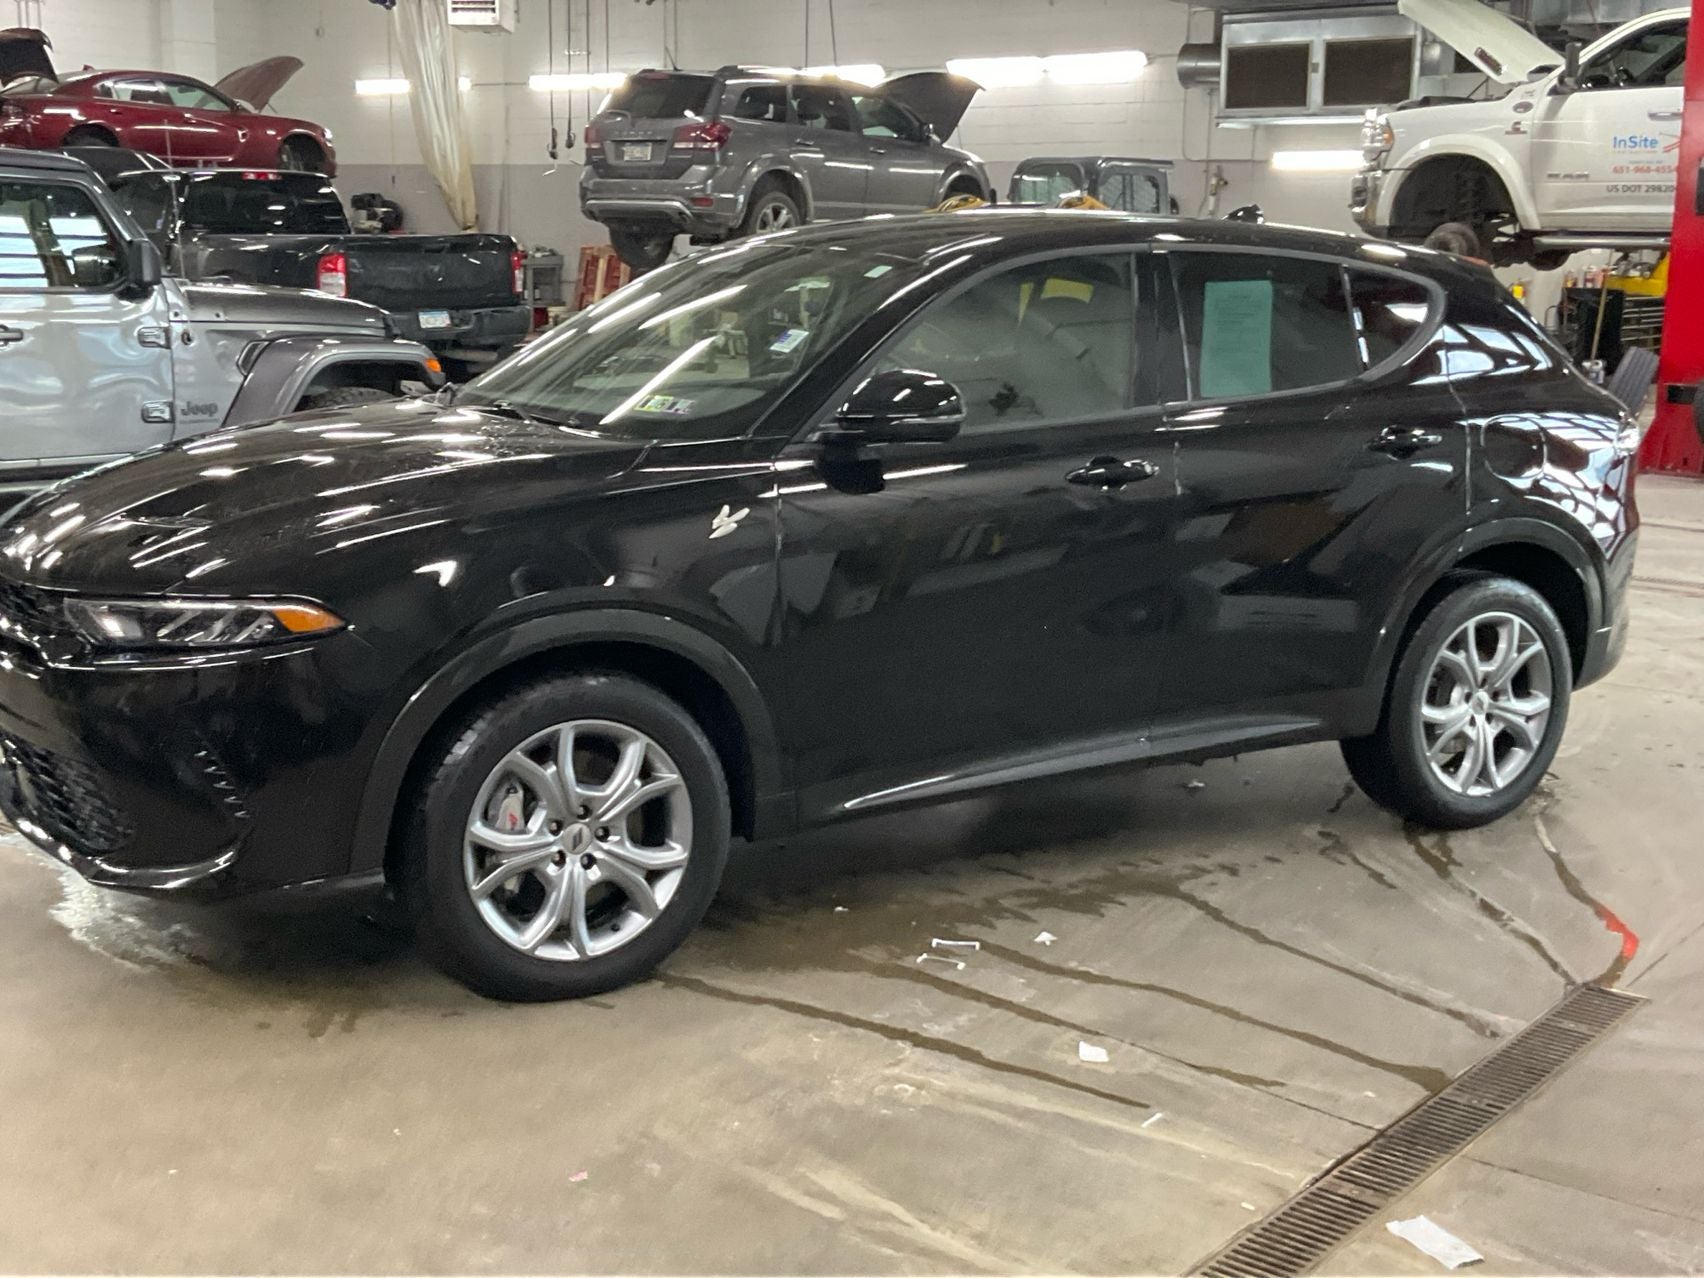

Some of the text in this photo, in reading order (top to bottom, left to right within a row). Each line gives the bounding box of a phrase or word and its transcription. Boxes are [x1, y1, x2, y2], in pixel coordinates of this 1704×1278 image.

[1612, 135, 1659, 149] InSite
[1612, 165, 1677, 174] 651-968-455
[1606, 184, 1620, 193] US
[1621, 184, 1643, 193] DOT
[180, 401, 219, 417] Jeep
